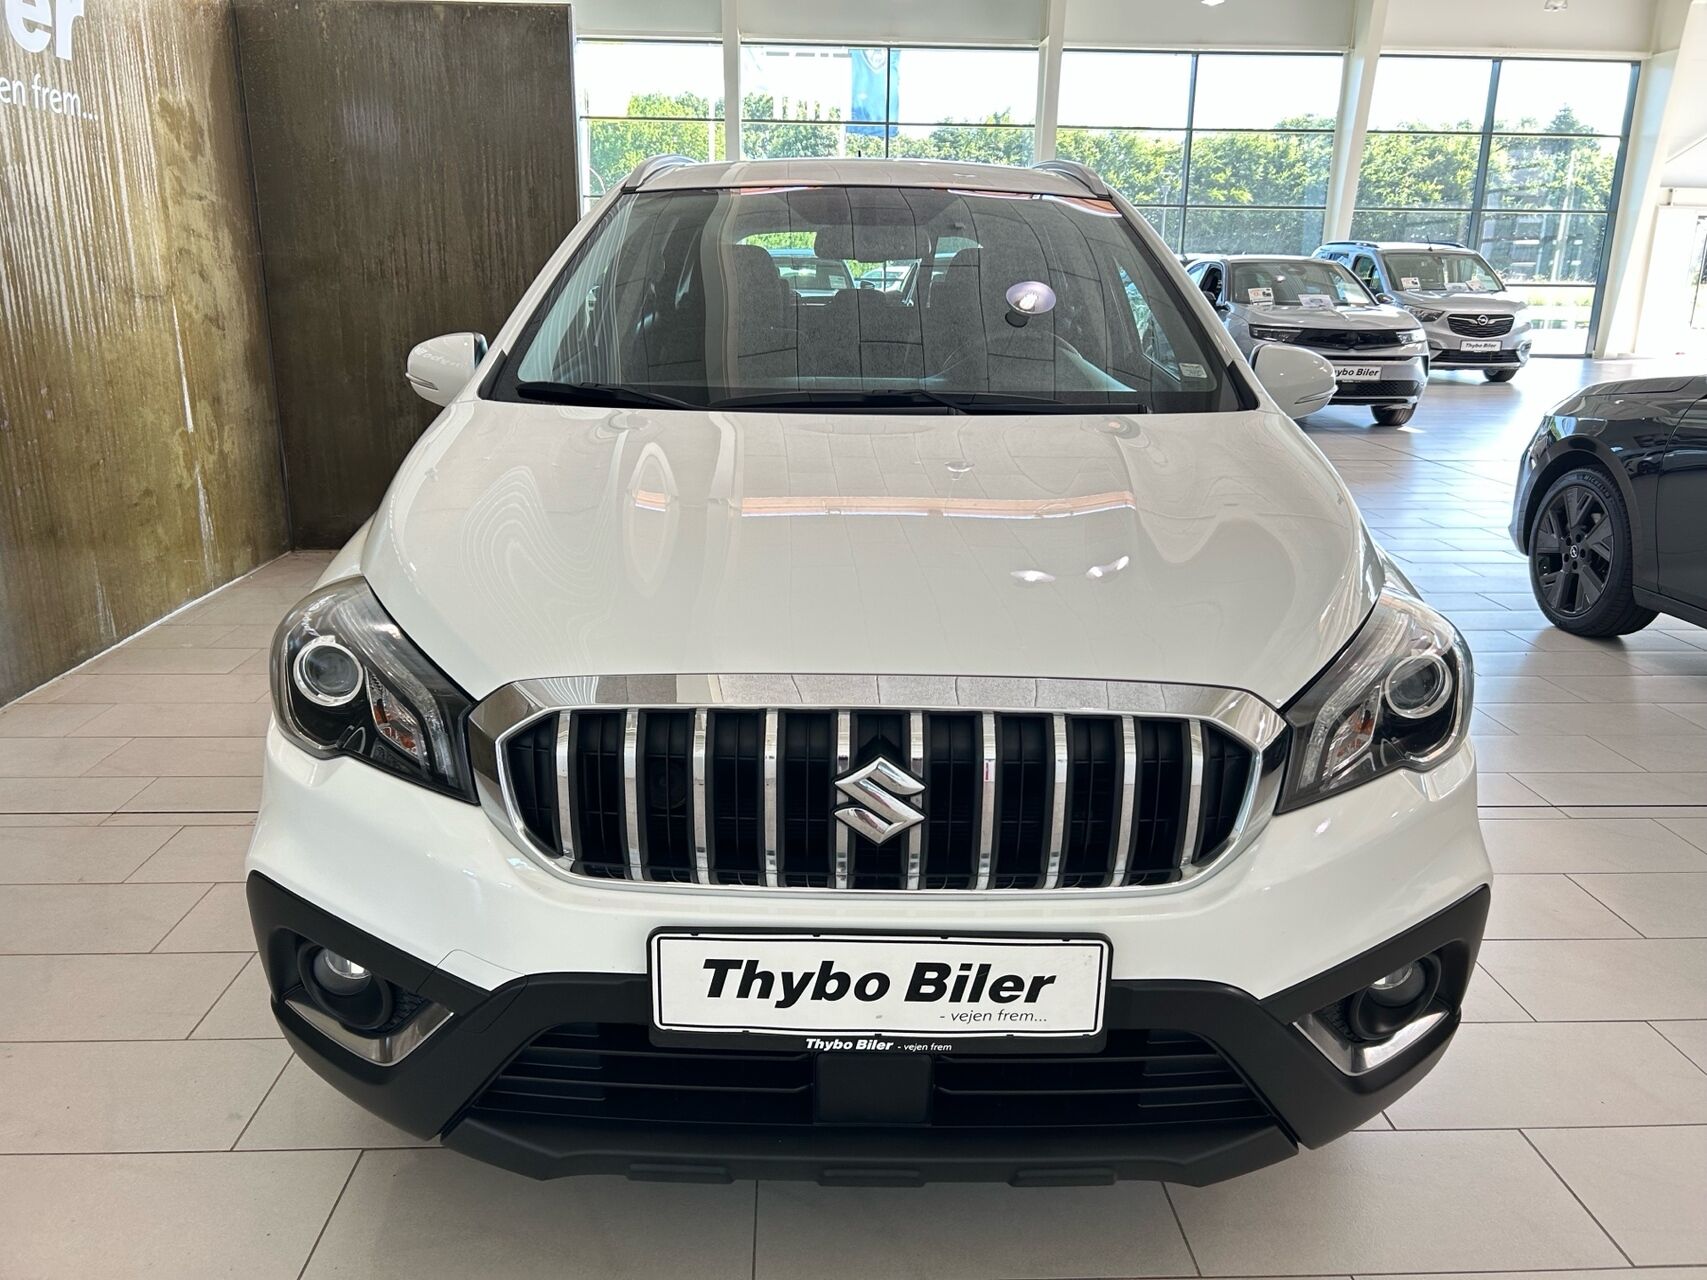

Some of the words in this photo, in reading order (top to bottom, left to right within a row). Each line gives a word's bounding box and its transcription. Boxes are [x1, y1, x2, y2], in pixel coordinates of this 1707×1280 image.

[1356, 368, 1380, 376] Biler
[703, 958, 891, 1008] Thybo
[904, 962, 1057, 1004] Biler
[951, 1010, 992, 1025] vejen
[997, 1008, 1047, 1023] frem...
[805, 1038, 853, 1051] Thybo
[855, 1039, 894, 1051] Biler
[903, 1043, 929, 1053] vejen
[930, 1042, 952, 1051] frem
